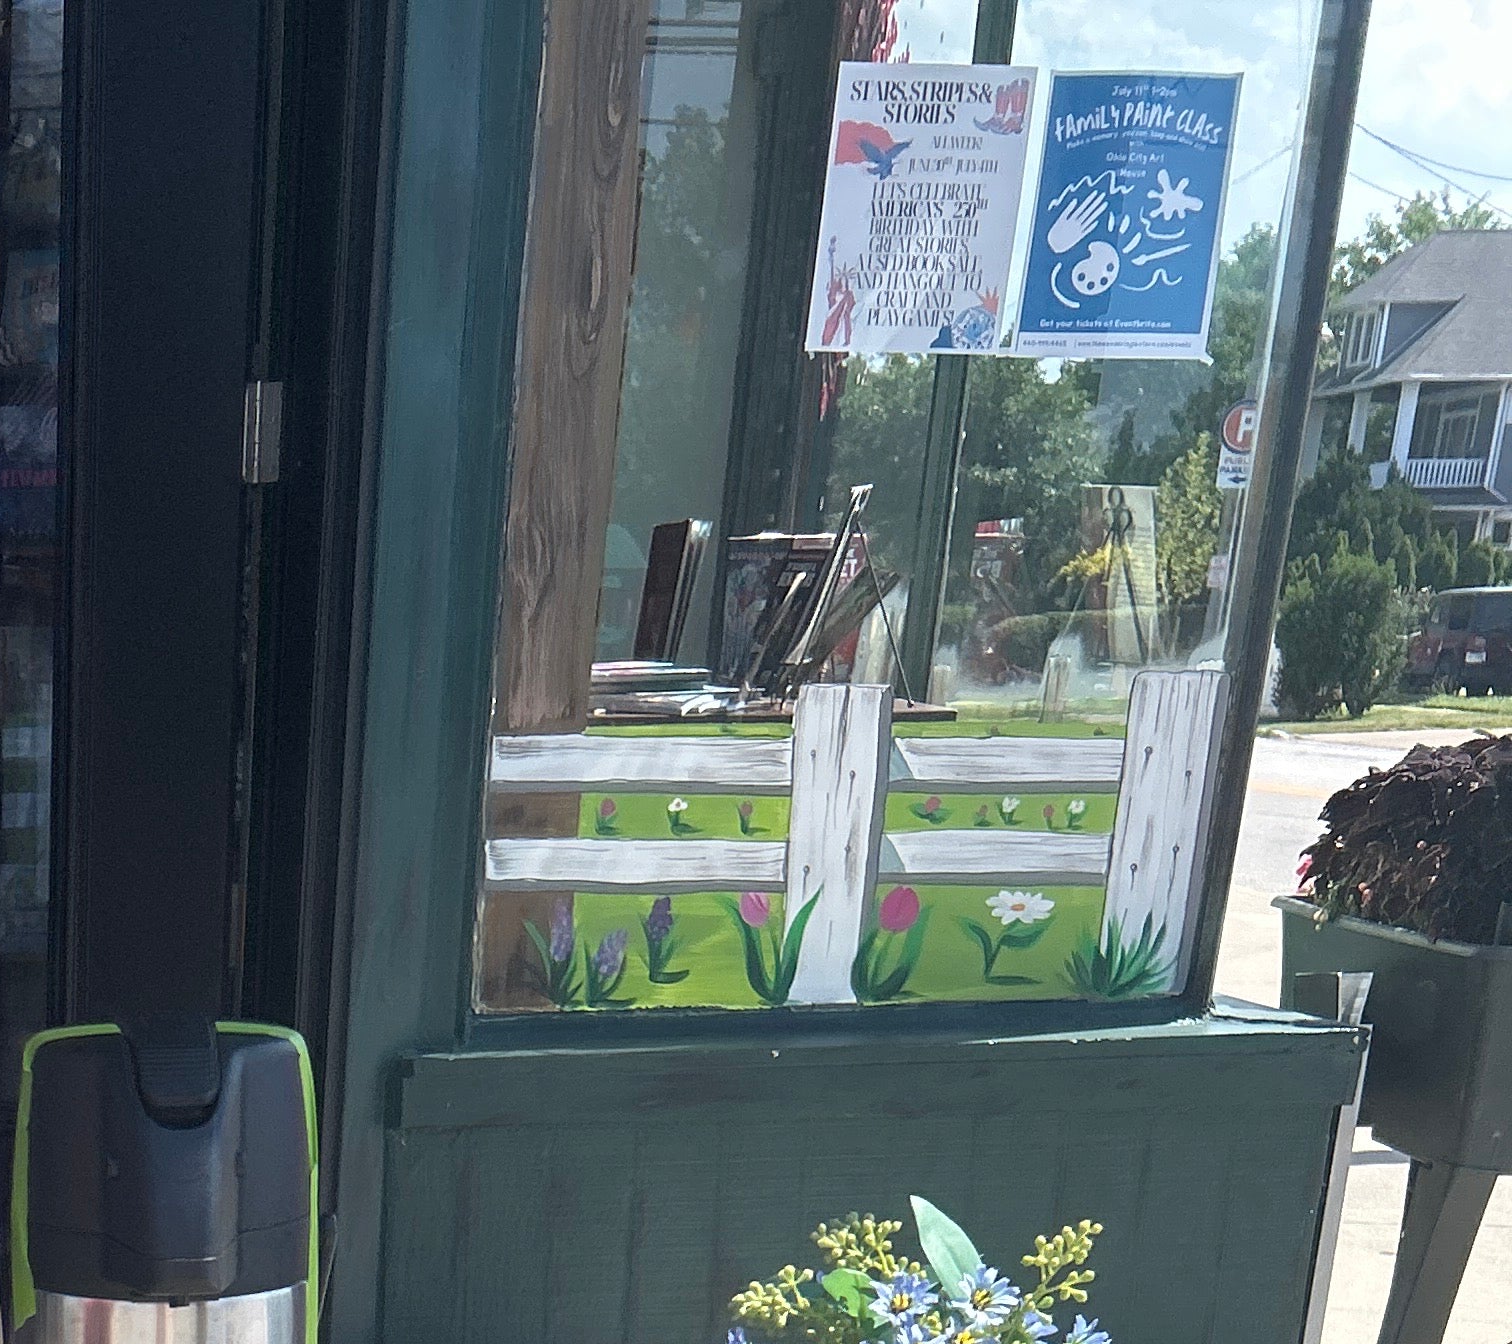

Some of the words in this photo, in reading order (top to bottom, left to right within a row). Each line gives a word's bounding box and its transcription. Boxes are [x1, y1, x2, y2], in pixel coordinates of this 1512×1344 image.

[1111, 85, 1132, 98] July
[883, 102, 956, 125] STORIES
[1129, 151, 1148, 165] City
[1149, 152, 1166, 163] Art
[869, 218, 935, 236] BIRTHDAY
[941, 219, 979, 237] WITH
[868, 236, 911, 254] GREAT
[867, 253, 903, 272] USED
[905, 254, 943, 272] BOOK
[855, 271, 883, 290] AND
[963, 273, 982, 291] TO
[876, 290, 919, 308] CRAFT
[922, 291, 952, 308] AND
[867, 308, 901, 327] PLAY
[1039, 318, 1054, 328] Get
